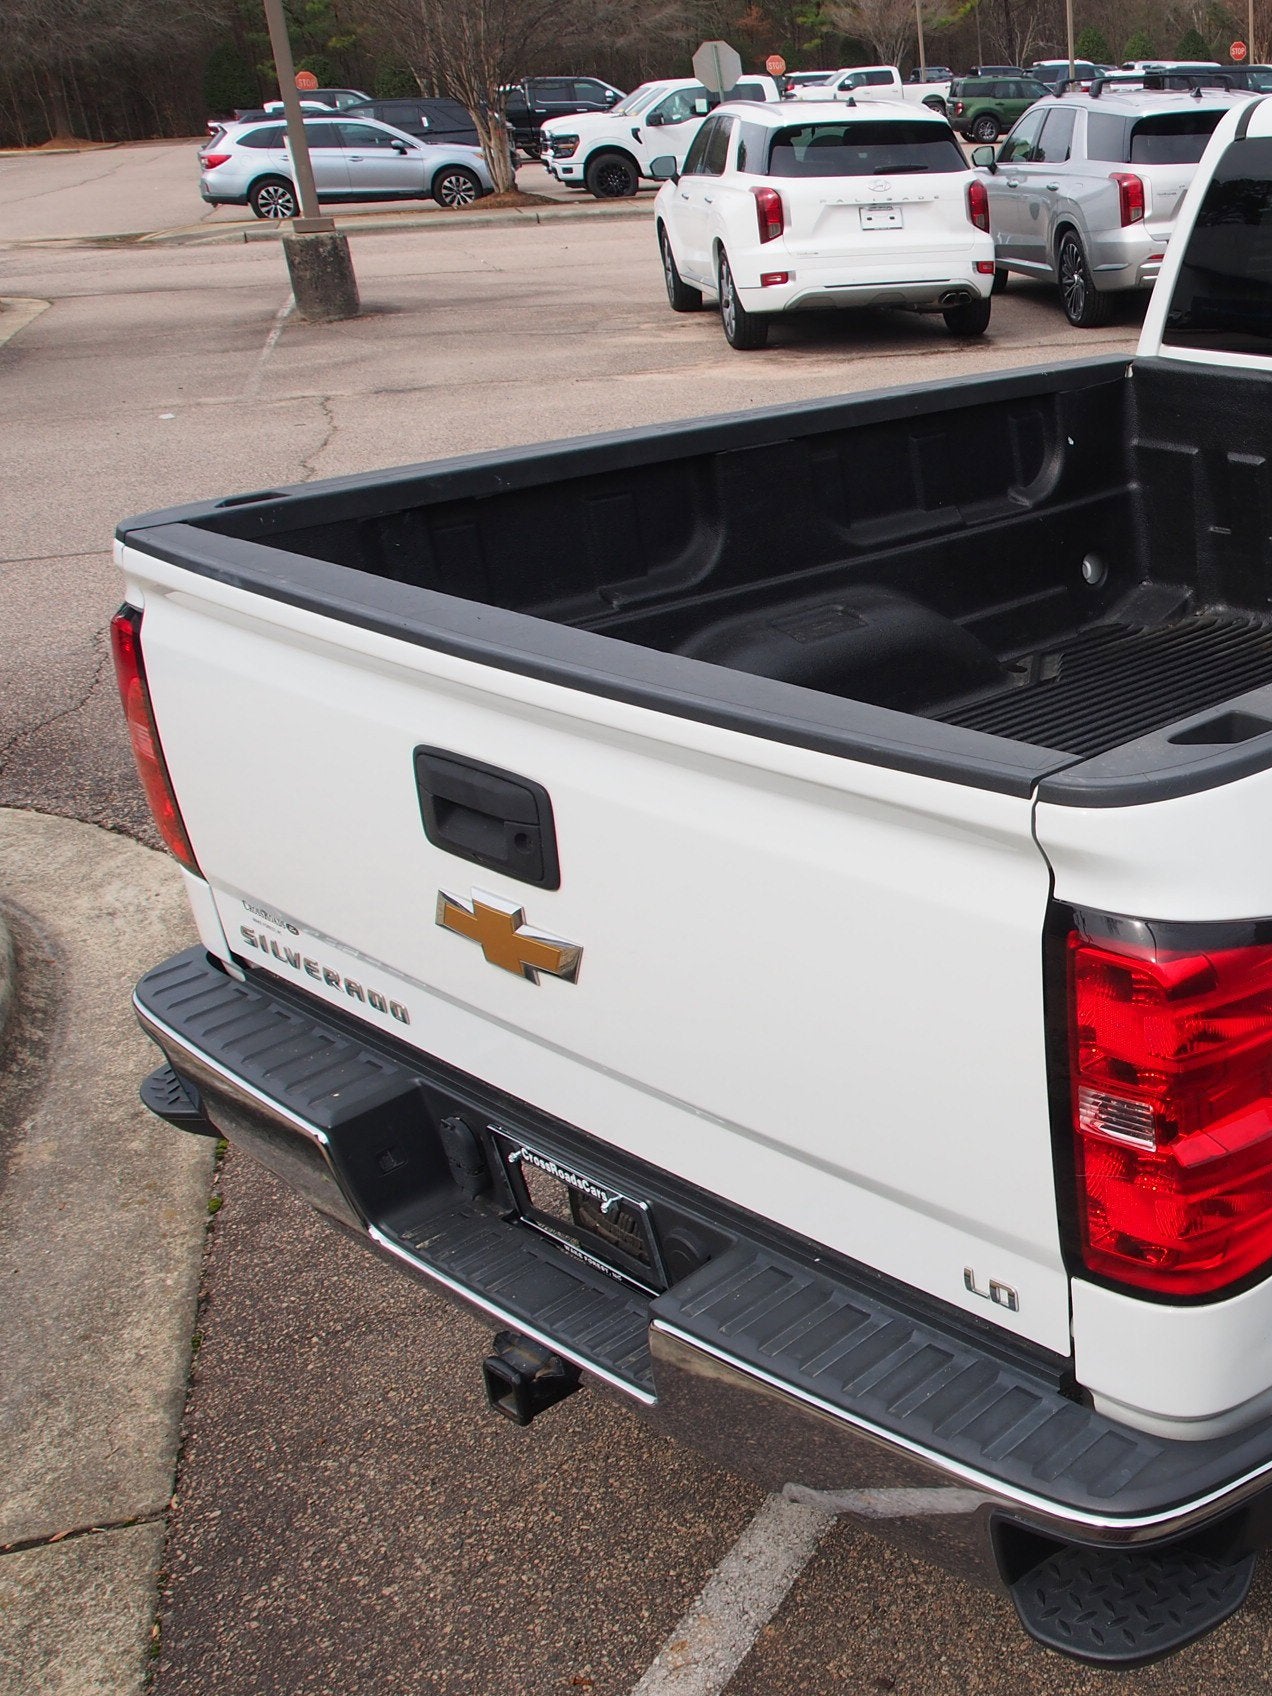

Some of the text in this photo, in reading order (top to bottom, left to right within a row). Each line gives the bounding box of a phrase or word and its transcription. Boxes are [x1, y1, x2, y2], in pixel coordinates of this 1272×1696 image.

[1231, 47, 1246, 55] STOP
[240, 925, 411, 1025] SILVERADO
[521, 1147, 608, 1203] CrossRoadsCars
[963, 1266, 1020, 1313] LD
